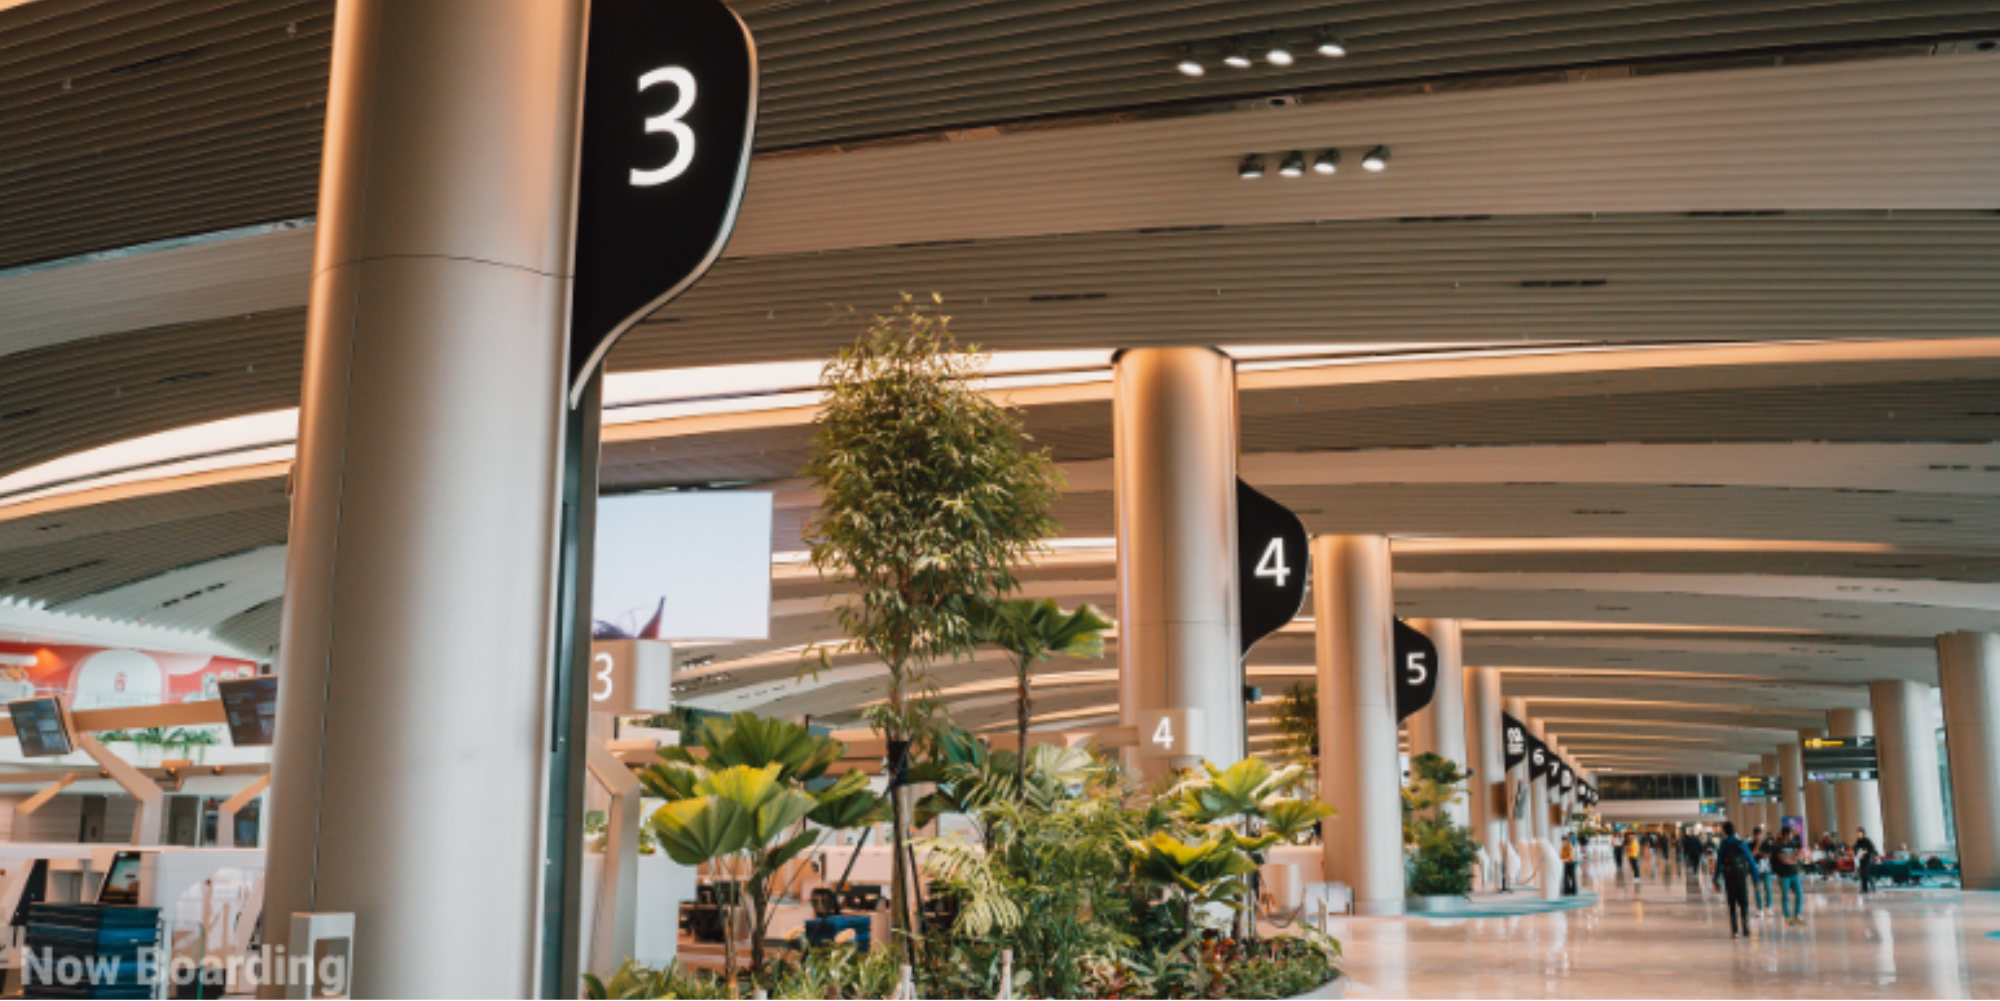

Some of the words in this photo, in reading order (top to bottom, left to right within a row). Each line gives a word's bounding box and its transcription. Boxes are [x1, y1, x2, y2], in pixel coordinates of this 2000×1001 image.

[629, 66, 697, 186] 3
[1254, 537, 1291, 587] 4
[592, 653, 614, 701] 3
[1407, 652, 1427, 684] 5
[1152, 716, 1174, 749] 4
[1533, 748, 1545, 766] 6
[1549, 761, 1560, 777] 7
